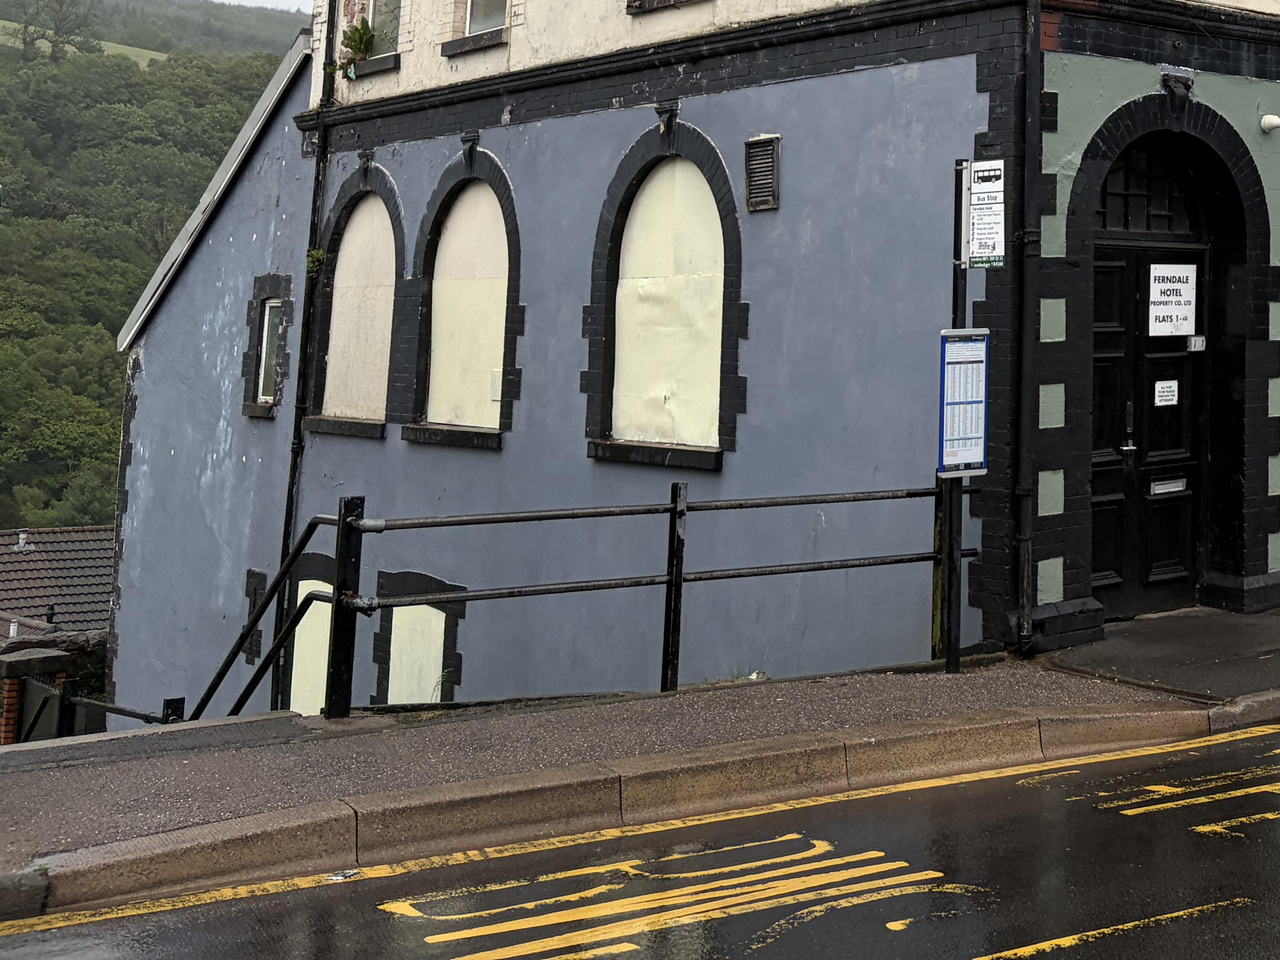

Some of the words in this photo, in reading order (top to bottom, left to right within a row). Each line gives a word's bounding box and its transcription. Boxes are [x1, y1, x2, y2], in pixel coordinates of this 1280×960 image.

[987, 194, 998, 202] Stop
[1153, 275, 1190, 284] FERNDALE
[1160, 288, 1182, 297] HOTEL
[1154, 315, 1173, 323] FLATS
